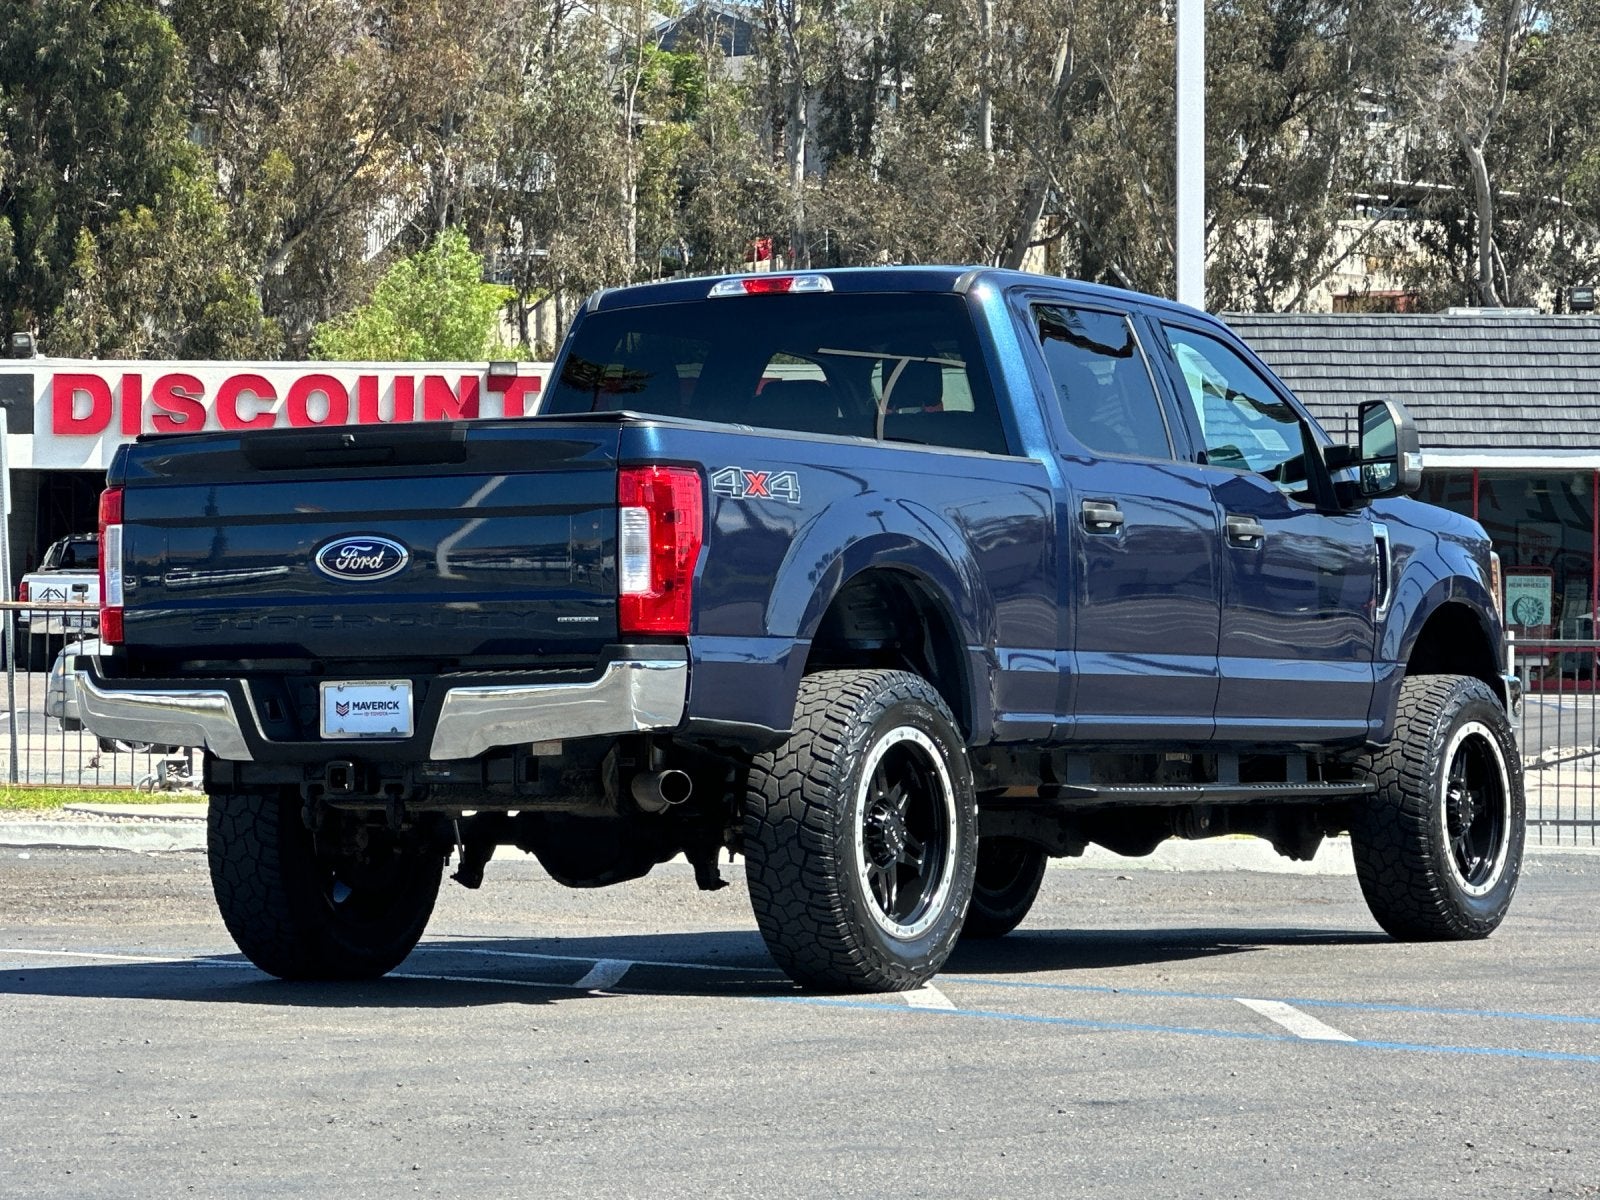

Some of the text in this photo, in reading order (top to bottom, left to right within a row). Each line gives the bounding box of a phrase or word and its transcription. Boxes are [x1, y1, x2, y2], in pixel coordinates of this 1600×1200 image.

[53, 373, 541, 435] DISCOUNT
[336, 545, 385, 569] Ford
[352, 701, 399, 711] MAVERICK
